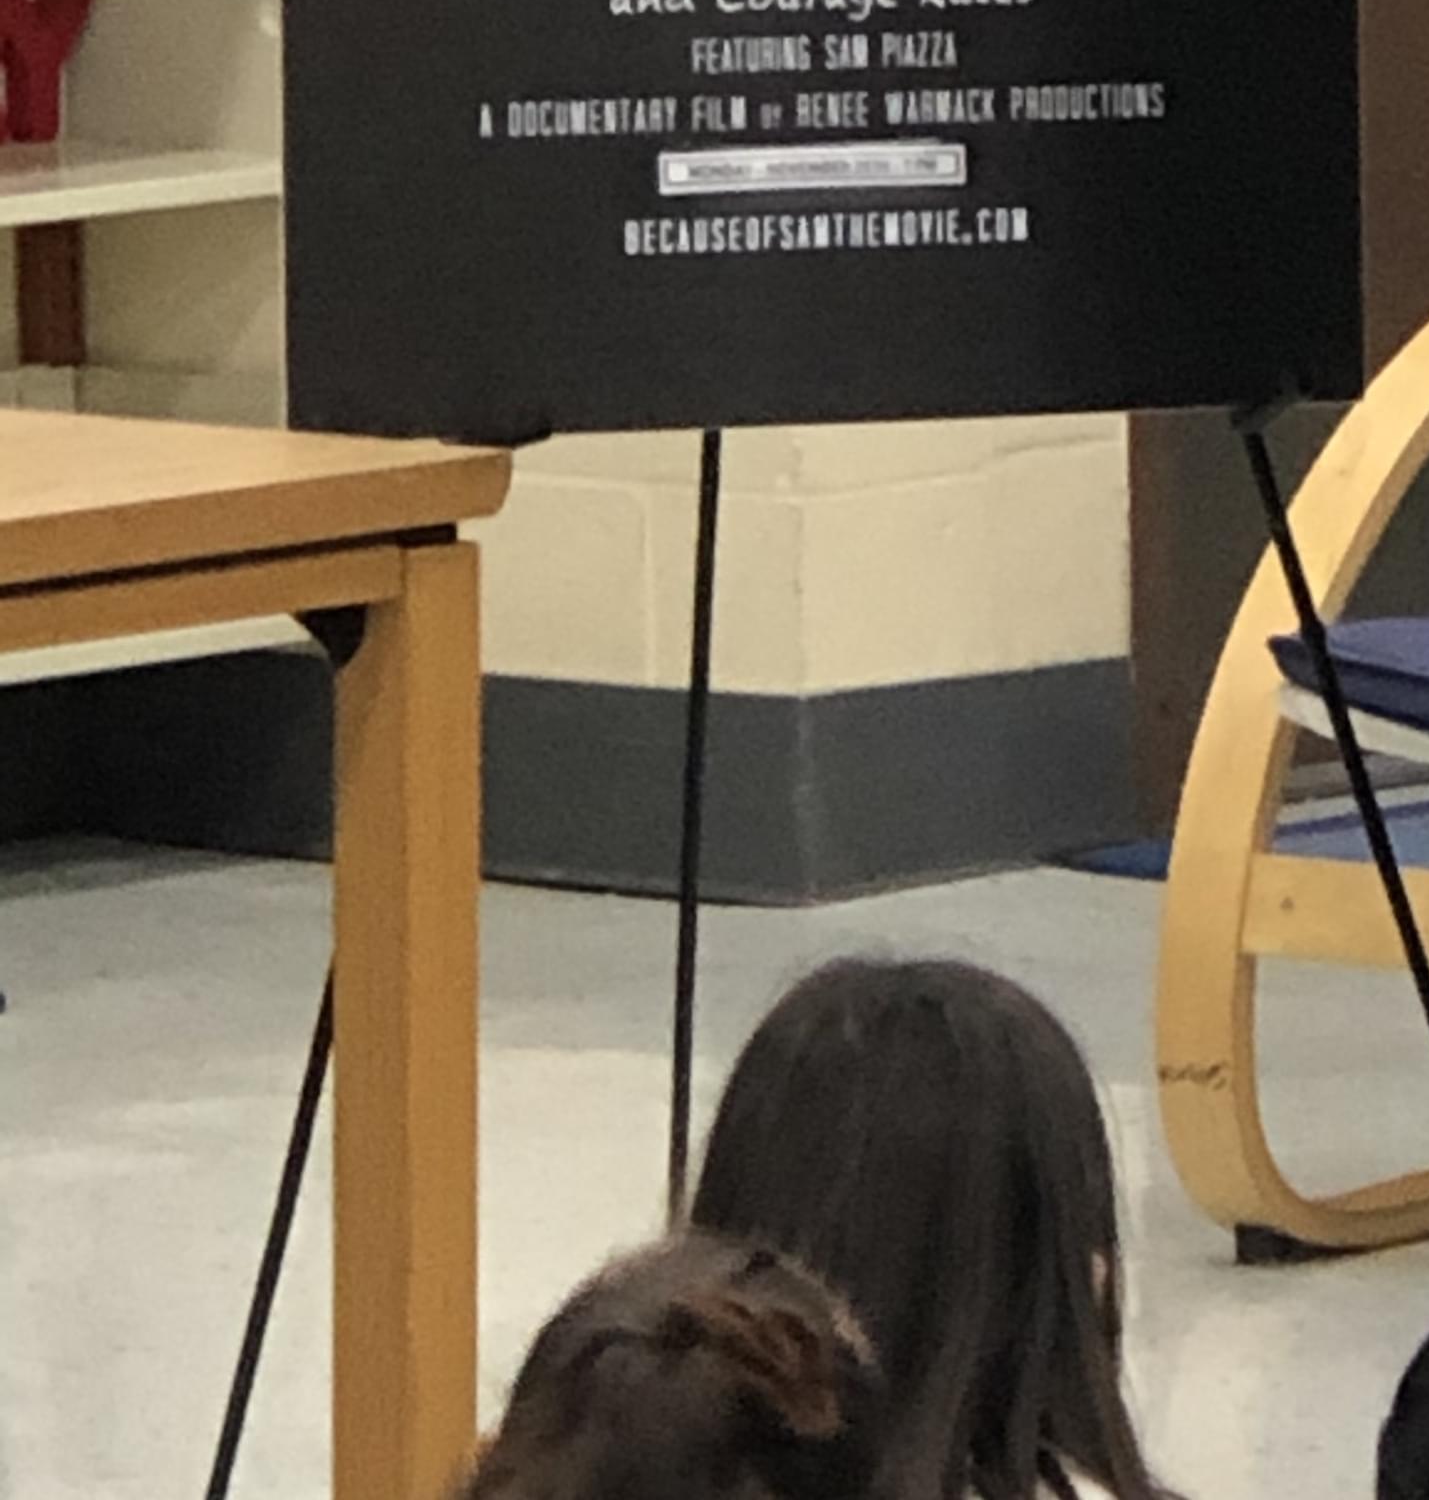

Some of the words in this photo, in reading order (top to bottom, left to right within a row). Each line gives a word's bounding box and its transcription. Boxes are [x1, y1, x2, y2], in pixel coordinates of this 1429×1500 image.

[691, 34, 811, 75] FEATURING
[825, 33, 868, 70] SAM
[881, 30, 957, 68] PIAZZA
[479, 103, 493, 138] A
[508, 97, 677, 137] DOCUMENTARY
[692, 95, 746, 131] FILM
[796, 91, 869, 128] RENEE
[883, 88, 995, 125] WARMACK
[1010, 83, 1165, 121] PRODUCTIONS
[624, 207, 1029, 256] BECAUSEOFSAMTHEMOVIE.COM
